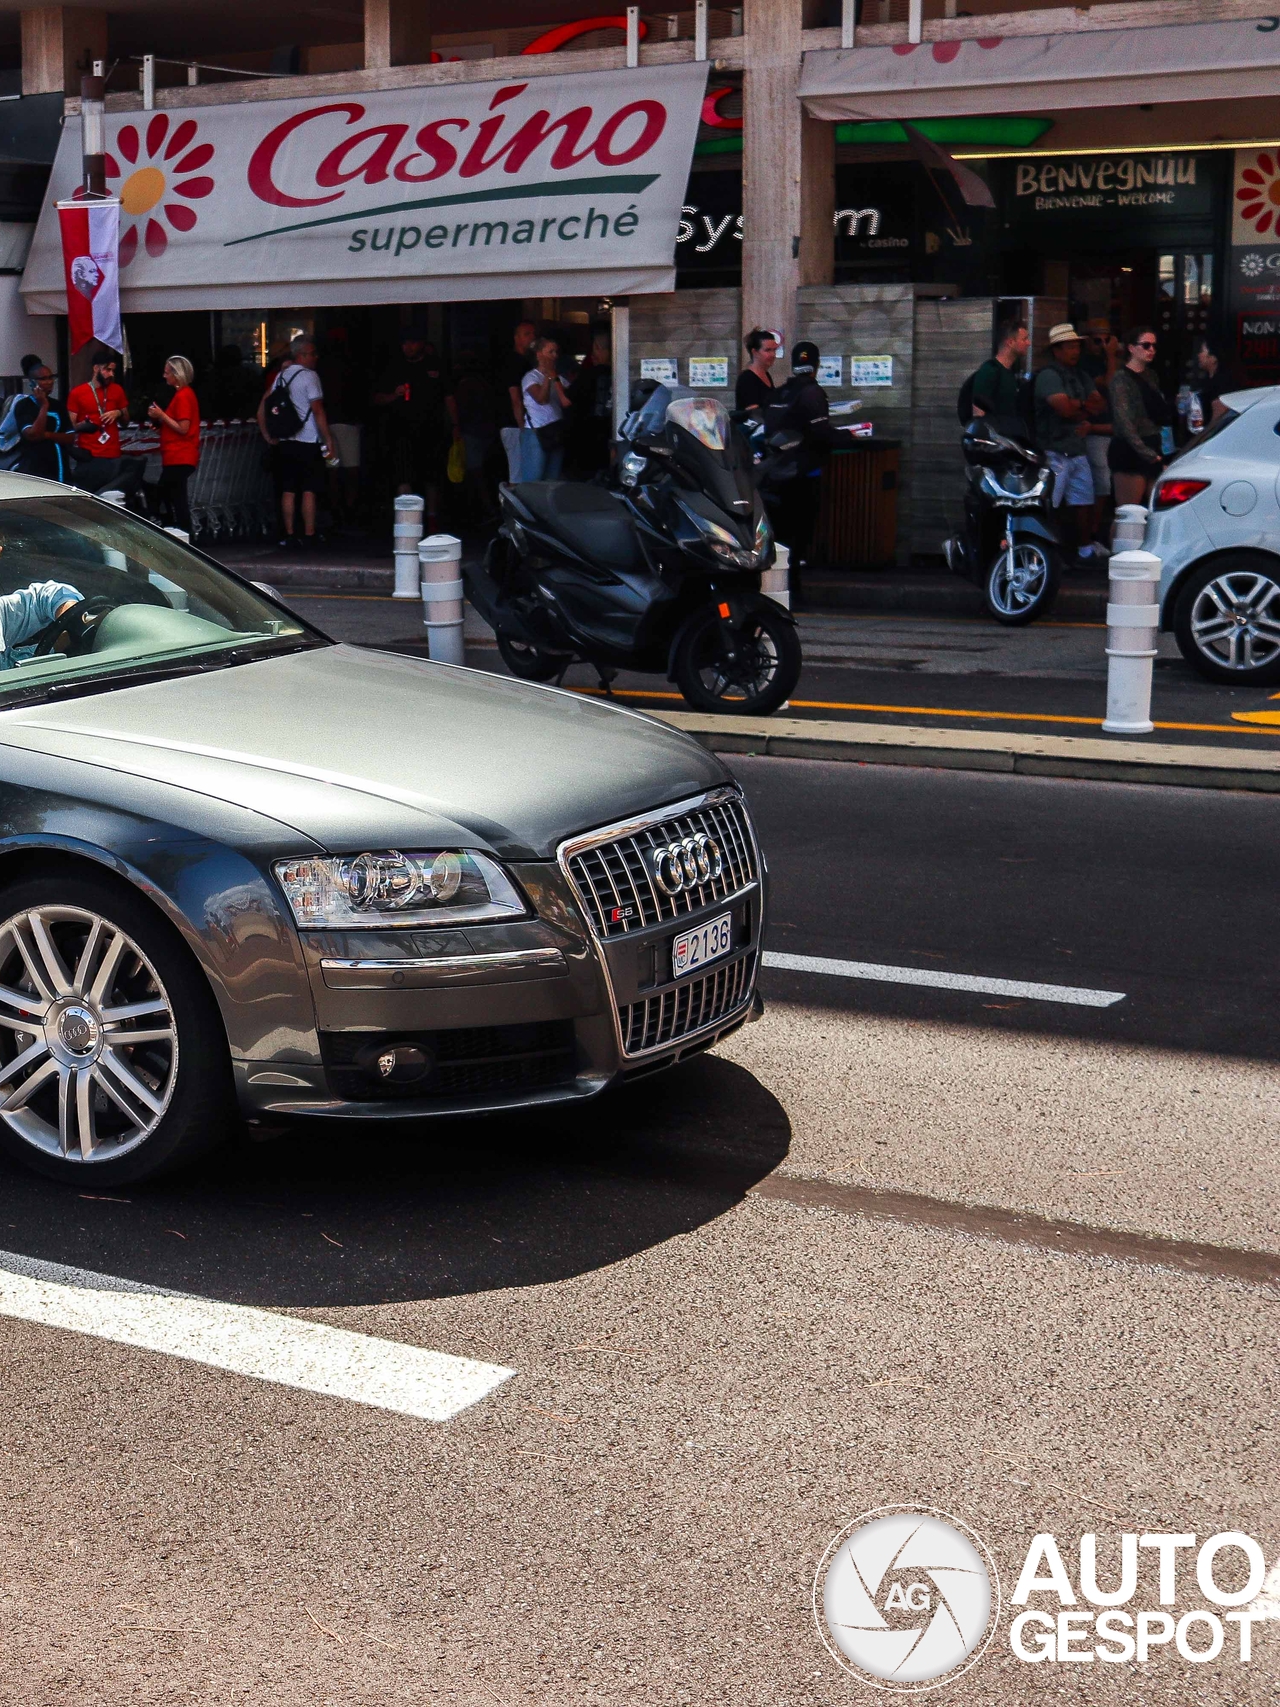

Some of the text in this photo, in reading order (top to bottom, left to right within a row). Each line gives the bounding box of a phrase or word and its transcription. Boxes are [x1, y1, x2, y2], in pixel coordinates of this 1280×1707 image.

[247, 82, 667, 208] Casino
[346, 204, 639, 256] supermarché
[868, 237, 909, 248] casino
[1243, 321, 1276, 335] NON
[689, 920, 728, 965] 2136
